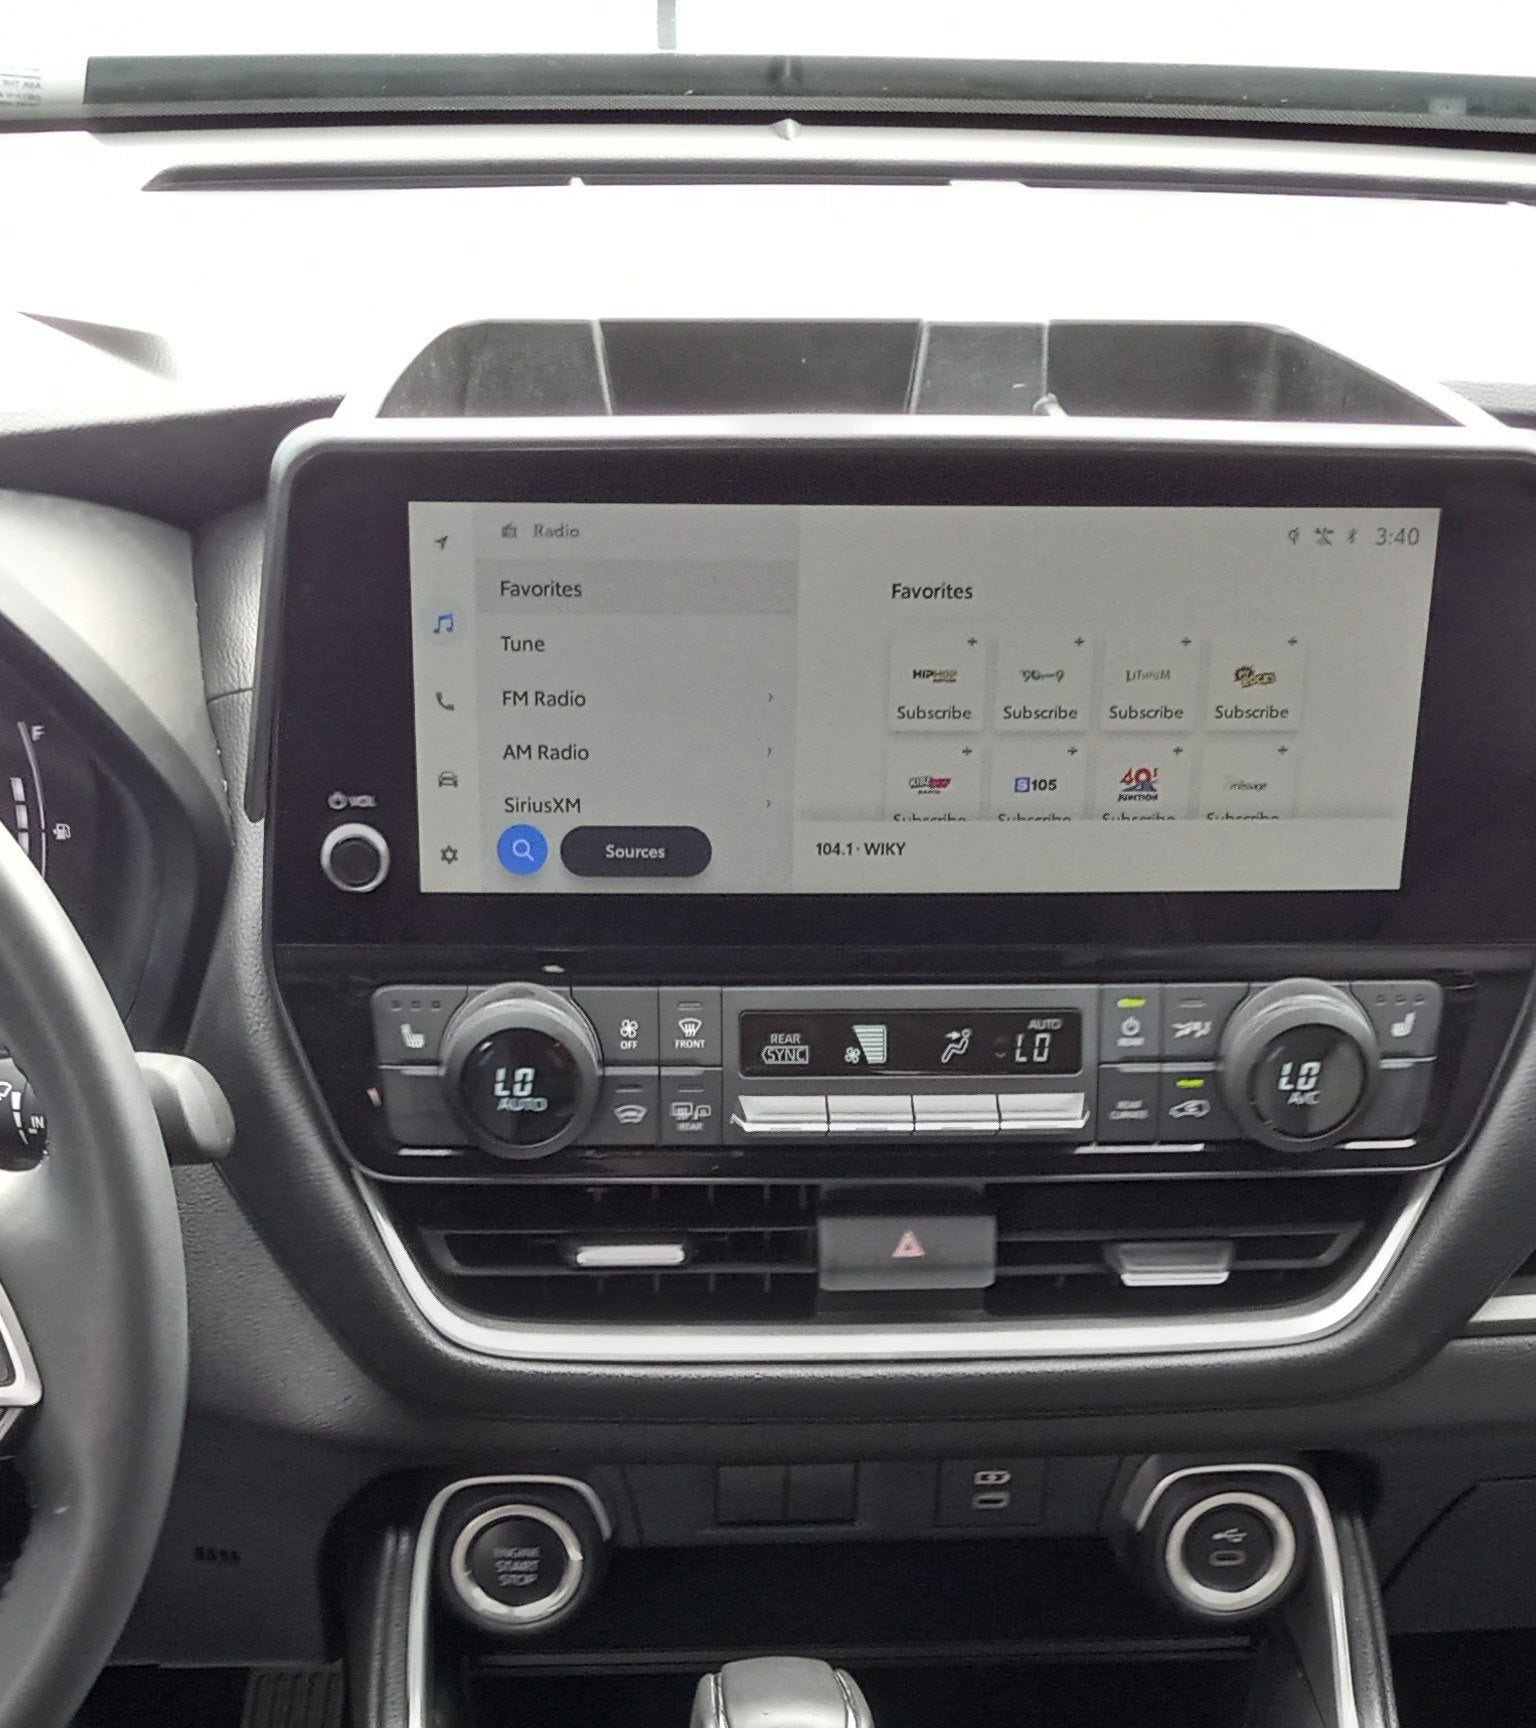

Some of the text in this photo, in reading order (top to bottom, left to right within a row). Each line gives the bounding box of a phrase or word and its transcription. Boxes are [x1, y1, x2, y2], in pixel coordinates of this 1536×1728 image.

[533, 523, 580, 539] Radio
[1375, 527, 1421, 546] 3:40
[500, 580, 583, 599] Favorites
[891, 582, 973, 601] Favorites
[501, 635, 545, 653] Tune
[502, 690, 587, 707] FM Radio
[896, 705, 972, 720] Subscribe
[1002, 705, 1078, 720] Subscribe
[1108, 705, 1184, 720] Subscribe
[1214, 704, 1290, 720] Subscribe
[502, 744, 590, 761] AM Radio
[504, 797, 582, 814] SiriusXM
[605, 844, 666, 860] Sources
[815, 841, 906, 857] 104.1 WIKY
[1027, 1019, 1061, 1030] AUTO
[620, 1040, 638, 1050] OFF
[675, 1039, 706, 1049] FRONT
[770, 1033, 801, 1045] REAR
[767, 1047, 806, 1063] SYNC
[496, 1097, 549, 1112] AUTO
